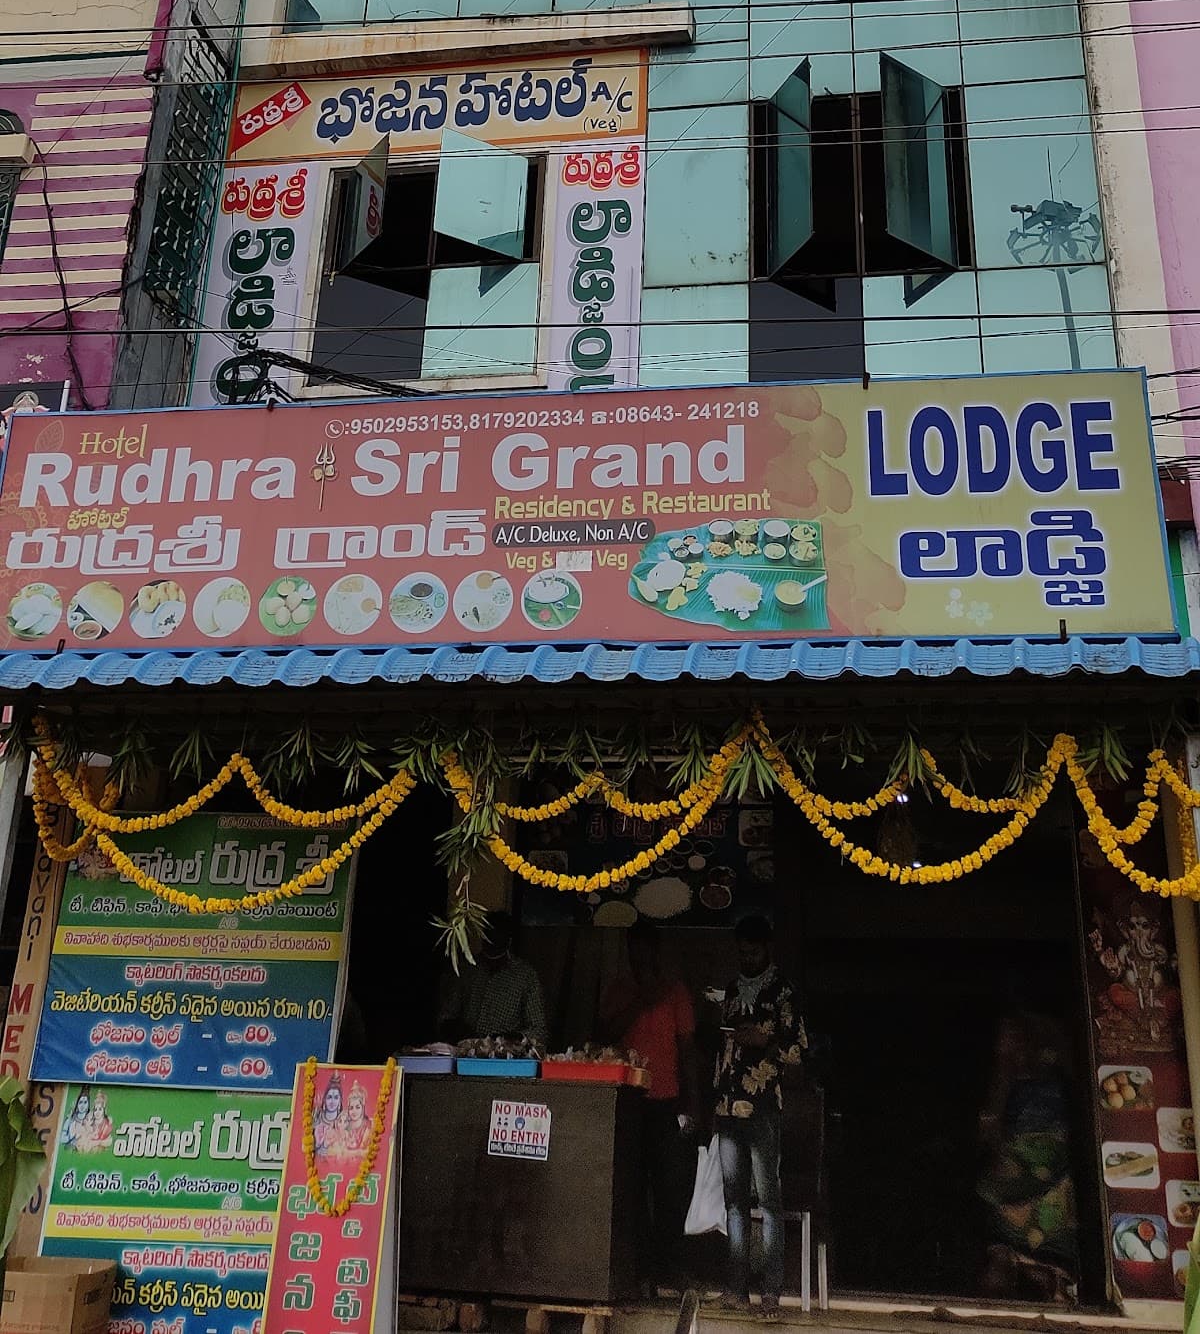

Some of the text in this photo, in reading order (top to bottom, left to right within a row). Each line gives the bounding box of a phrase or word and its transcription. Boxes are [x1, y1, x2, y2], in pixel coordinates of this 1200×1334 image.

[591, 75, 634, 114] A/C
[562, 145, 642, 189] రుద్రశ్రీ
[220, 167, 309, 220] రుద్రశ్రీ
[688, 401, 760, 421] 241218
[78, 423, 148, 461] Hotel
[866, 400, 1122, 497] LODGE
[18, 424, 746, 508] Rudhra Sri Grand
[66, 507, 130, 531] హోటల్
[494, 488, 772, 520] Residency & Restaurant
[5, 508, 487, 575] రుద్రశ్రీ గ్రాండ్
[495, 521, 650, 546] A/C Deluxe, Non A/C
[505, 551, 554, 573] Veg &
[596, 549, 629, 571] Veg
[899, 508, 1108, 607] లాడ్జి
[495, 1103, 548, 1119] NO MASK
[113, 1116, 204, 1159] హోటల్
[492, 1128, 546, 1144] NO ENTRY
